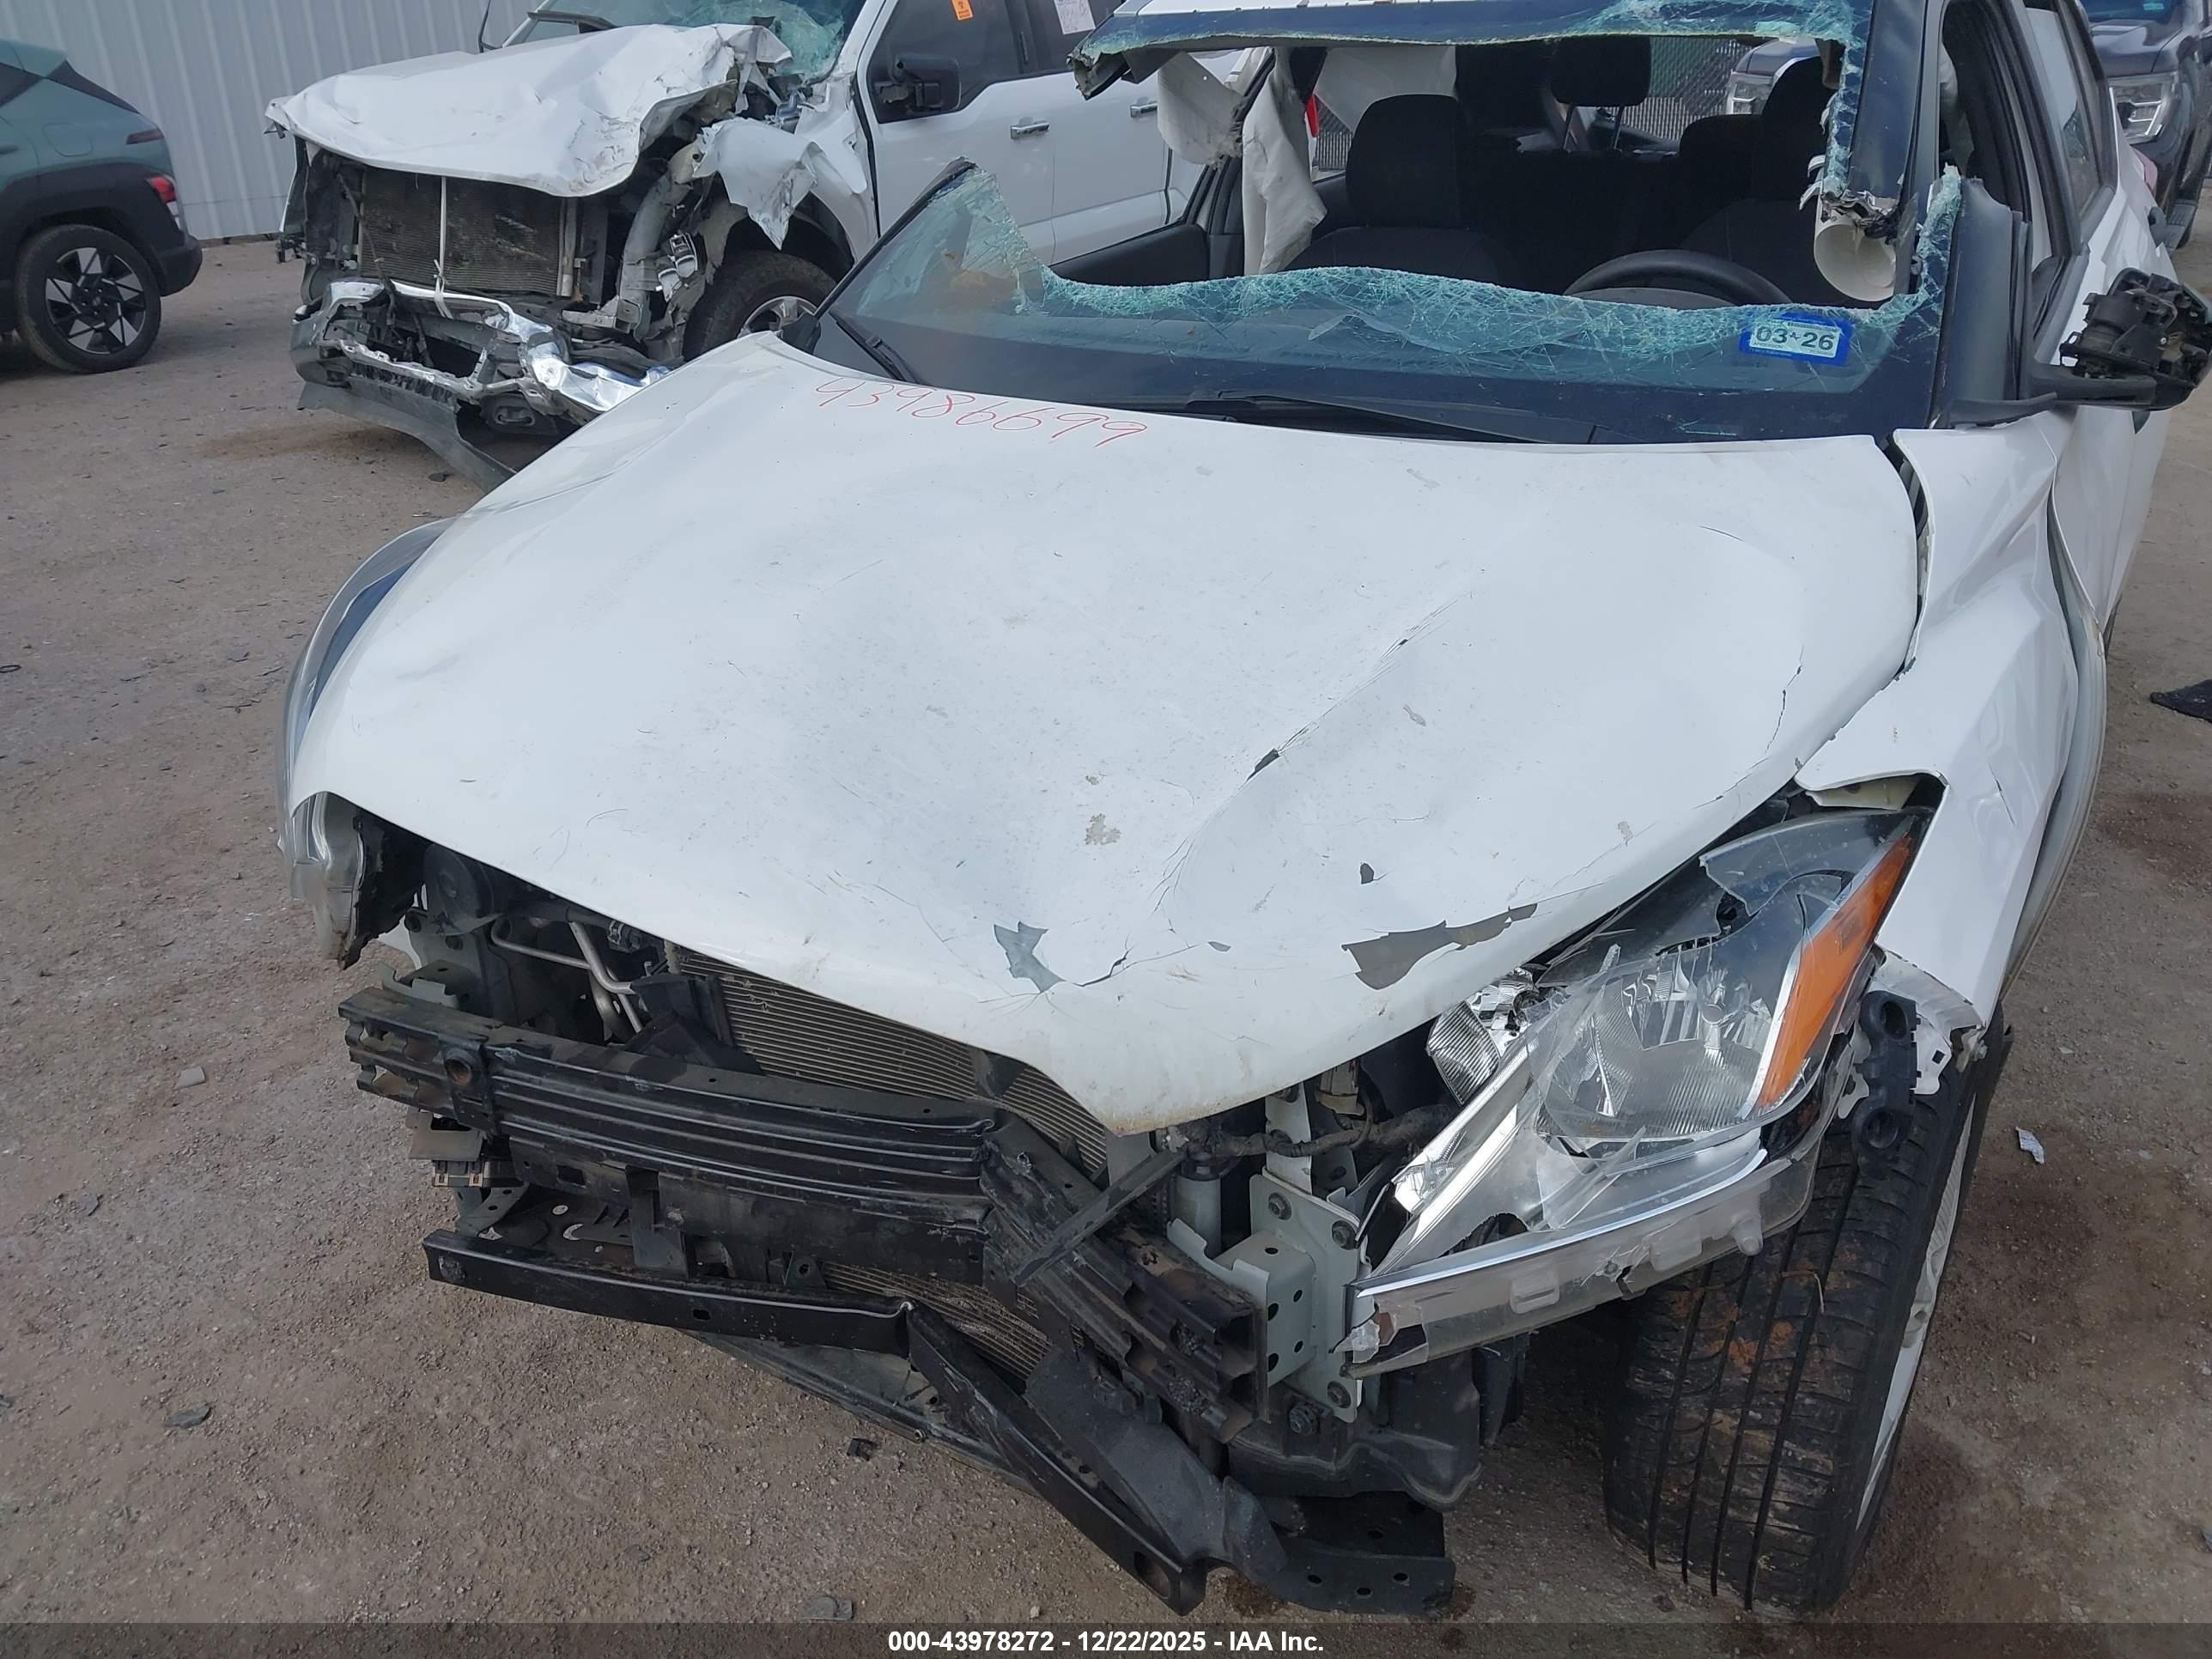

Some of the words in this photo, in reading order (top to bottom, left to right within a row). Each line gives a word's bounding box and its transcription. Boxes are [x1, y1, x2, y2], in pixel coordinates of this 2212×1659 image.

[1756, 325, 1788, 344] 03
[1801, 331, 1835, 351] 26
[816, 377, 1148, 447] 43986699
